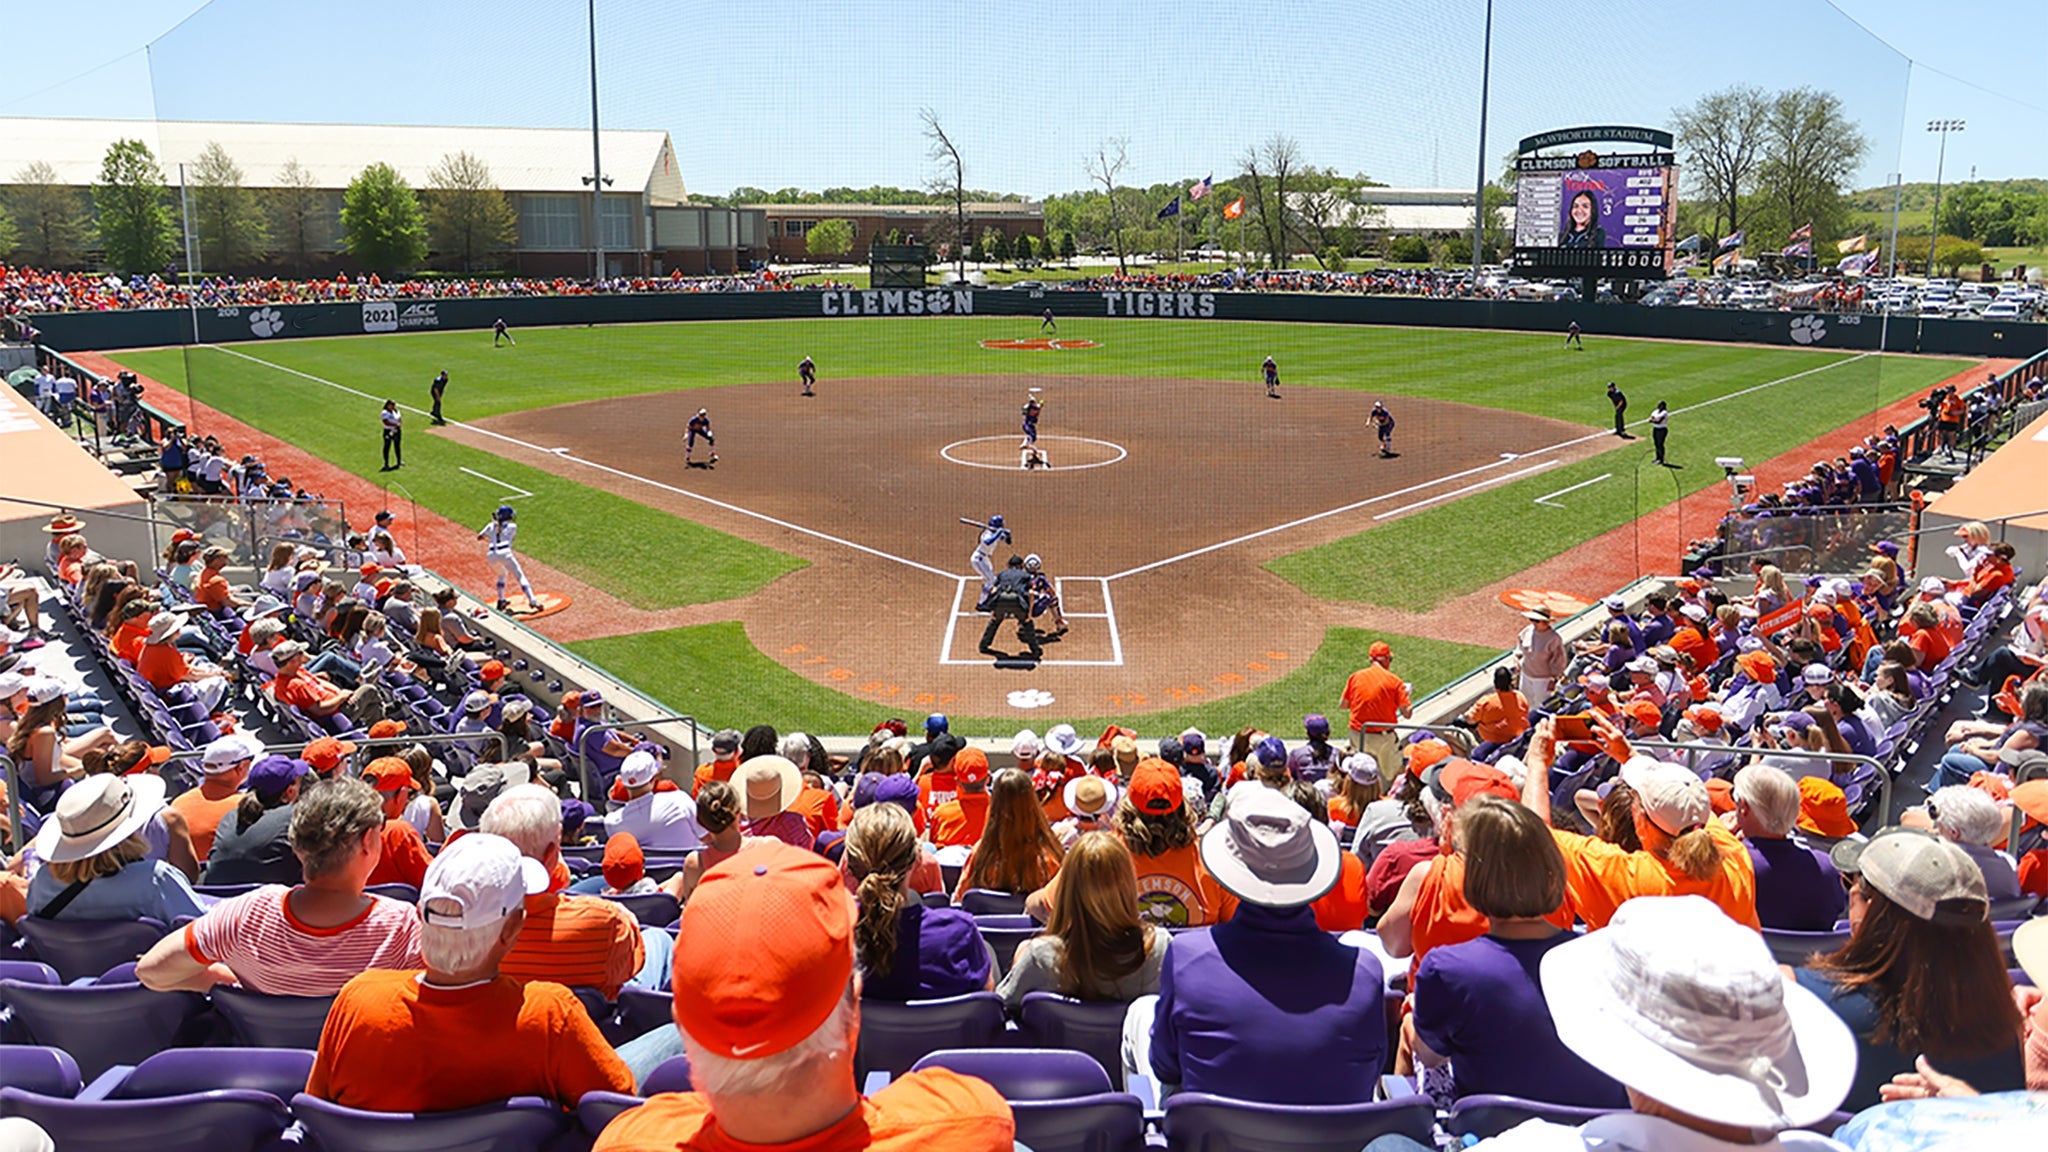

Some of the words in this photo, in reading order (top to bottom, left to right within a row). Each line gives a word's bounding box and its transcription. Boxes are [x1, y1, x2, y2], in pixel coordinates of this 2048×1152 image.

[1603, 128, 1654, 142] STADIUM
[1521, 158, 1577, 170] CLEMSON
[1598, 156, 1666, 168] SOFTBALL
[400, 303, 436, 317] ACC
[1102, 291, 1215, 317] TIGERS
[217, 307, 240, 317] 200
[364, 309, 397, 324] 2021
[400, 316, 439, 327] CHAMPIONS
[1138, 878, 1191, 901] EMSON
